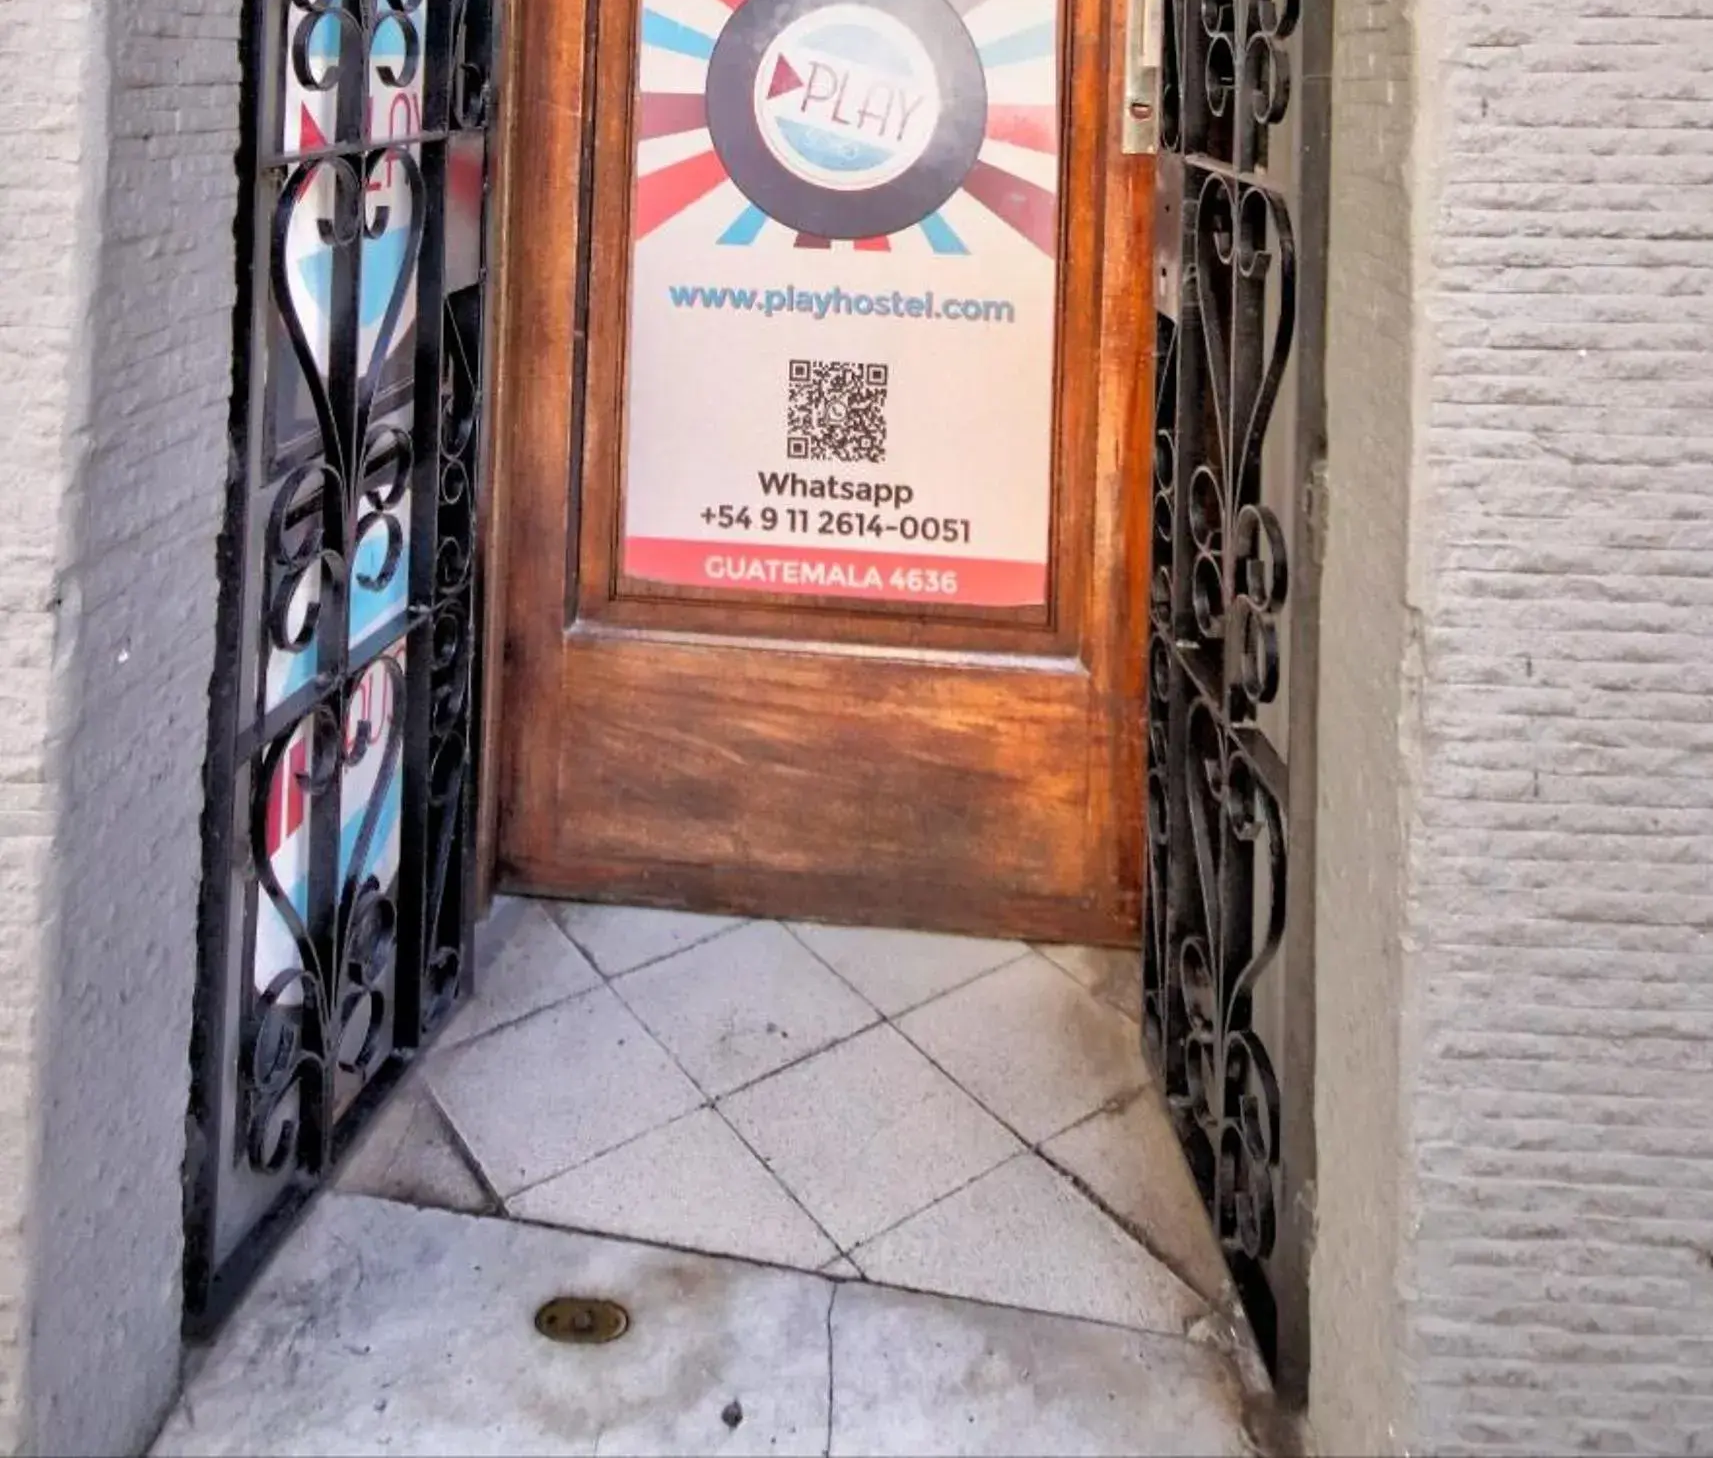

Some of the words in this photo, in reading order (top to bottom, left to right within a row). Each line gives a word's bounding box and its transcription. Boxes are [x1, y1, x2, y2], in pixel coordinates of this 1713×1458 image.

[801, 61, 925, 142] PLAY
[669, 283, 1015, 323] www.playhostel.com
[758, 471, 914, 509] Whatsapp
[700, 505, 752, 531] +54
[760, 507, 778, 531] 9
[787, 510, 809, 533] 11
[818, 512, 972, 544] 2614-0051
[705, 555, 882, 590] GUATEMALA
[890, 567, 957, 594] 4636
